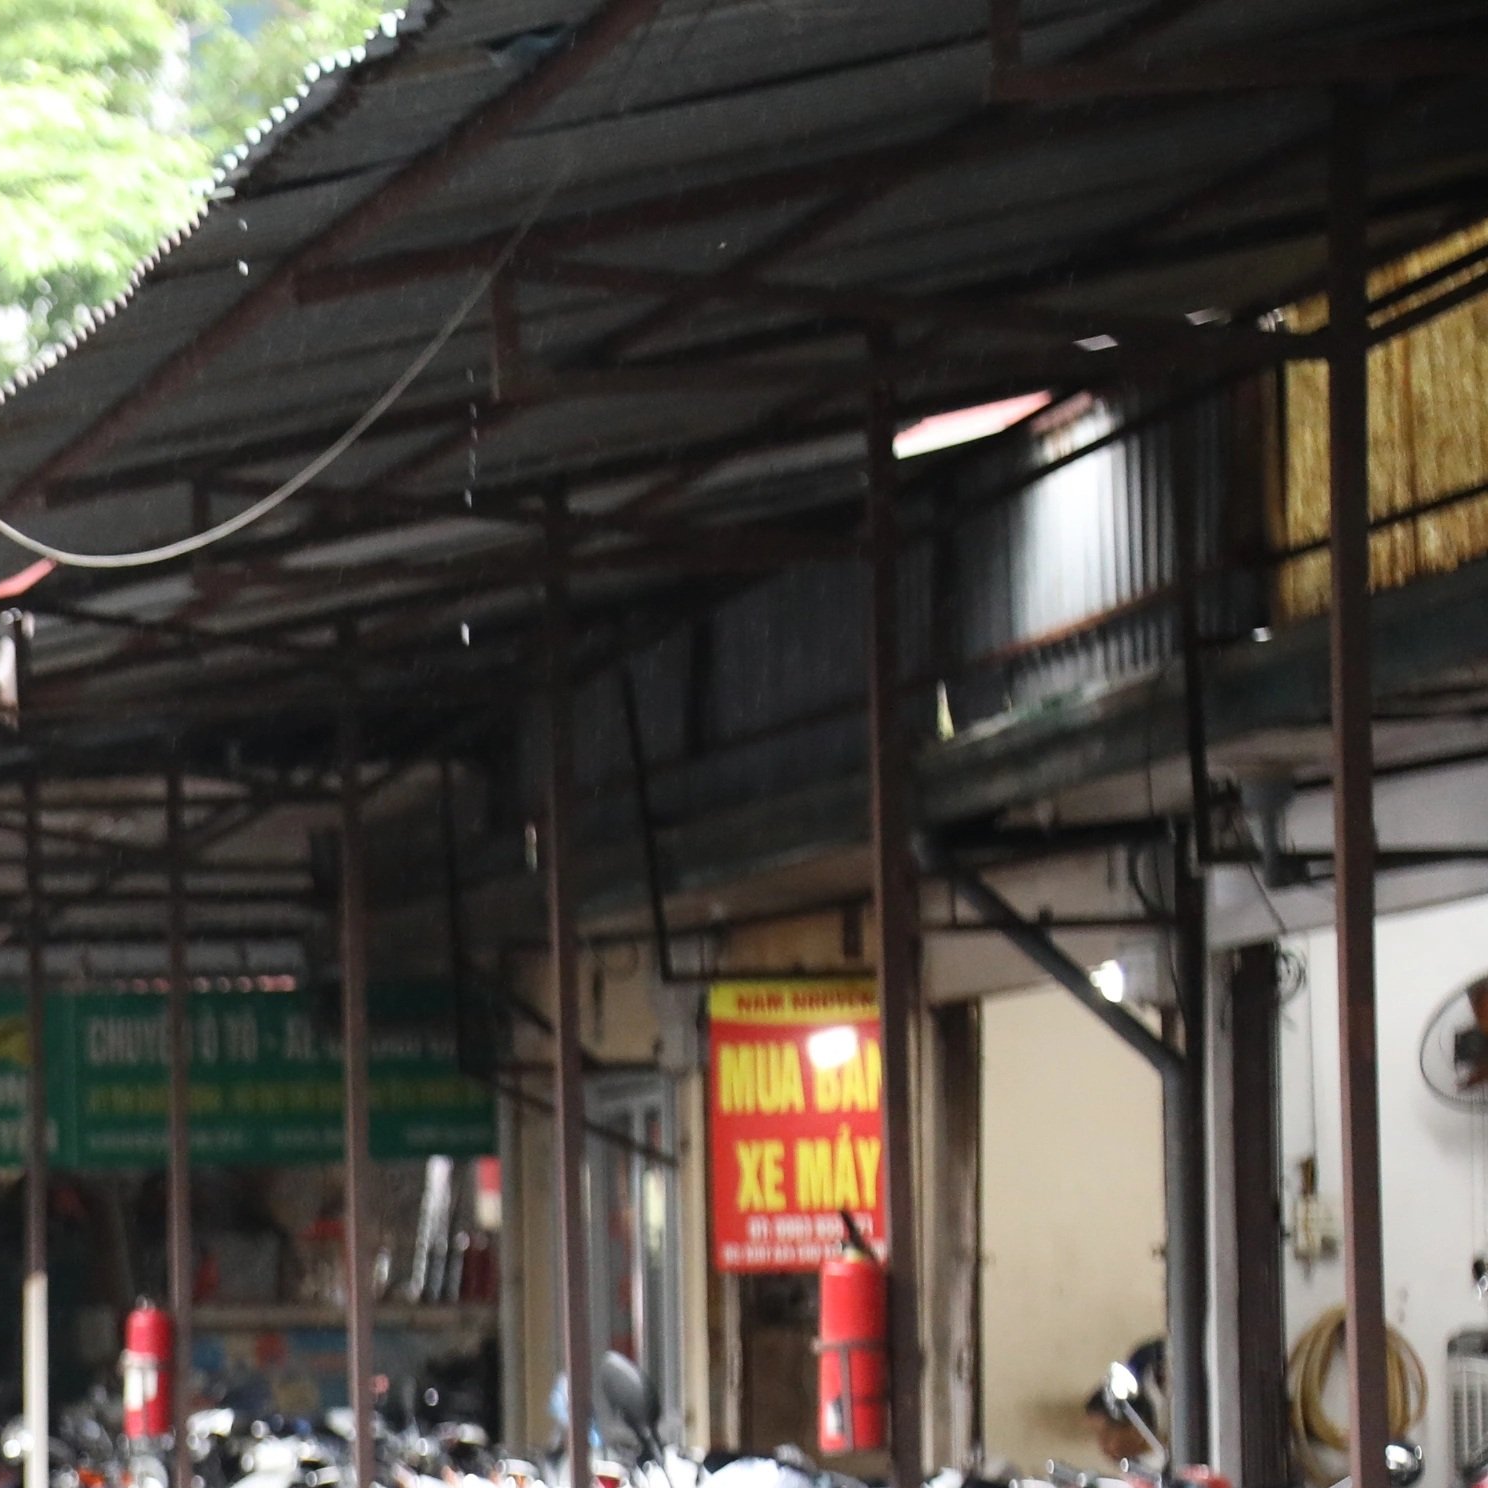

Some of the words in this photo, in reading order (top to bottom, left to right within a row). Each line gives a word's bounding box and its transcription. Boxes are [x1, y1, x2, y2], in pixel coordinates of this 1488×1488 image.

[719, 1040, 807, 1115] MUA
[736, 1138, 788, 1214] XE
[795, 1121, 881, 1212] MÁY
